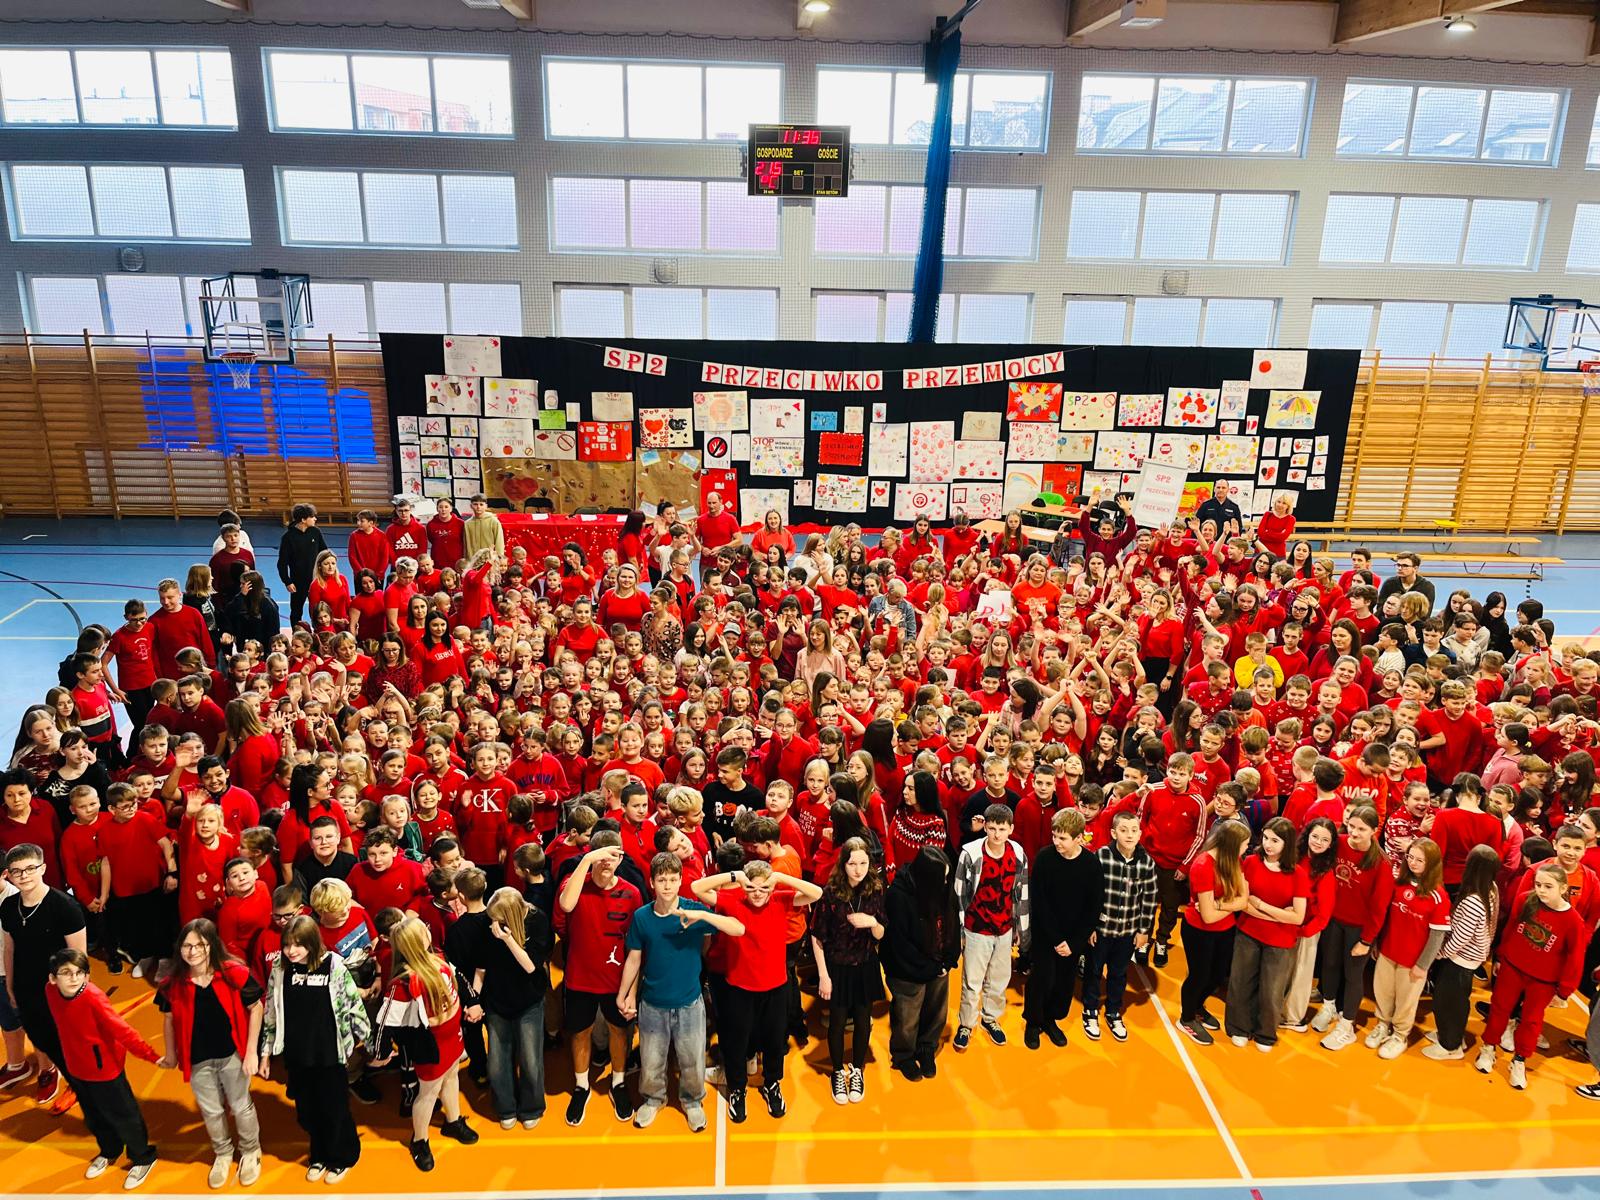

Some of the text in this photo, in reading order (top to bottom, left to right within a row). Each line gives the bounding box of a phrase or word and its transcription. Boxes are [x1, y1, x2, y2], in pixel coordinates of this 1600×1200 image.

[757, 148, 793, 158] GOSPODARZE
[818, 146, 838, 159] GOŚCIE
[607, 350, 1063, 390] SP2 PRZECIWKO PRZEMOCY
[1068, 395, 1088, 406] SP2
[753, 437, 774, 446] STOP
[1155, 474, 1171, 483] SP2
[395, 542, 418, 550] adidas
[1341, 785, 1379, 800] NASA
